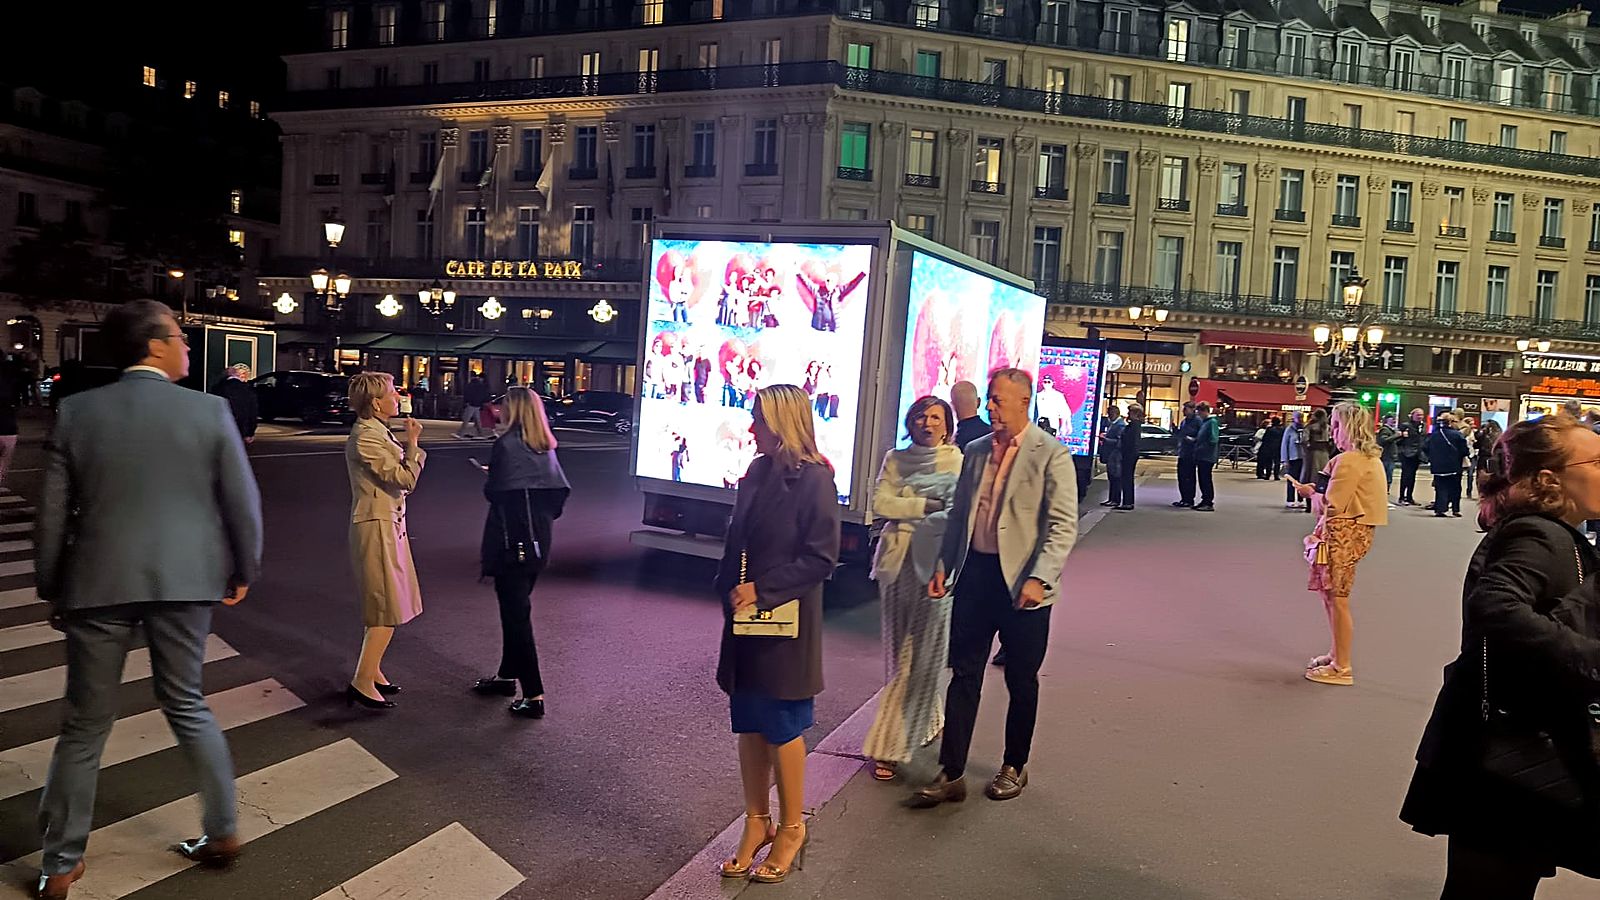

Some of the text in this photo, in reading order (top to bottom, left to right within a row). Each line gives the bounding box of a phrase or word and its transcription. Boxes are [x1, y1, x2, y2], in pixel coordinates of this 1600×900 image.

[491, 260, 512, 276] DE
[518, 260, 538, 276] LA
[544, 261, 582, 277] PAIX
[1121, 356, 1172, 373] Amorino
